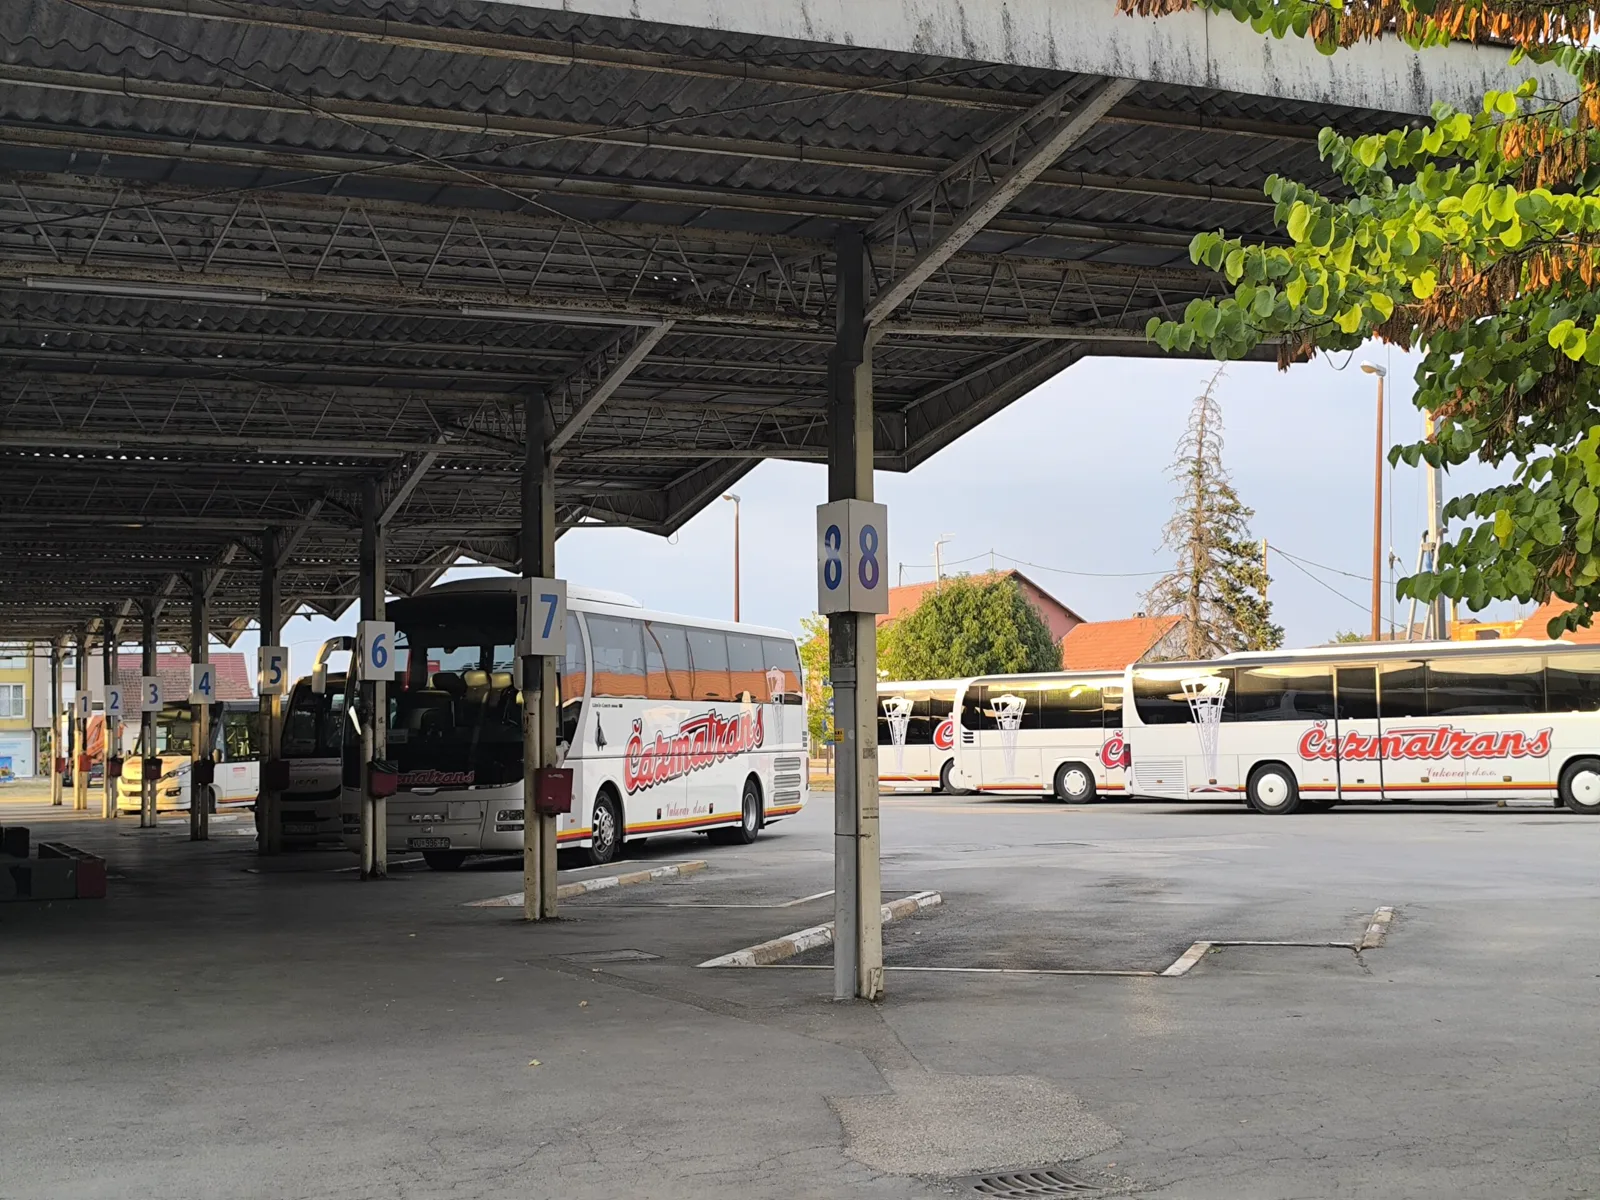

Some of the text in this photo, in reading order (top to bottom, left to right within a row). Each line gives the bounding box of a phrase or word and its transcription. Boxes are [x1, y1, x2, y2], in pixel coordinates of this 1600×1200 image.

[824, 524, 841, 591] 8
[858, 524, 879, 590] 8
[520, 595, 528, 640] 7
[540, 594, 558, 638] 7
[371, 633, 388, 668] 6
[199, 671, 211, 695] 4
[270, 656, 282, 685] 5
[81, 696, 87, 712] 1
[110, 691, 119, 709] 2
[149, 683, 158, 704] 3
[624, 704, 764, 796] Čazmatrans
[1297, 720, 1554, 760] Čazmatrans
[1426, 767, 1471, 778] Vukovar
